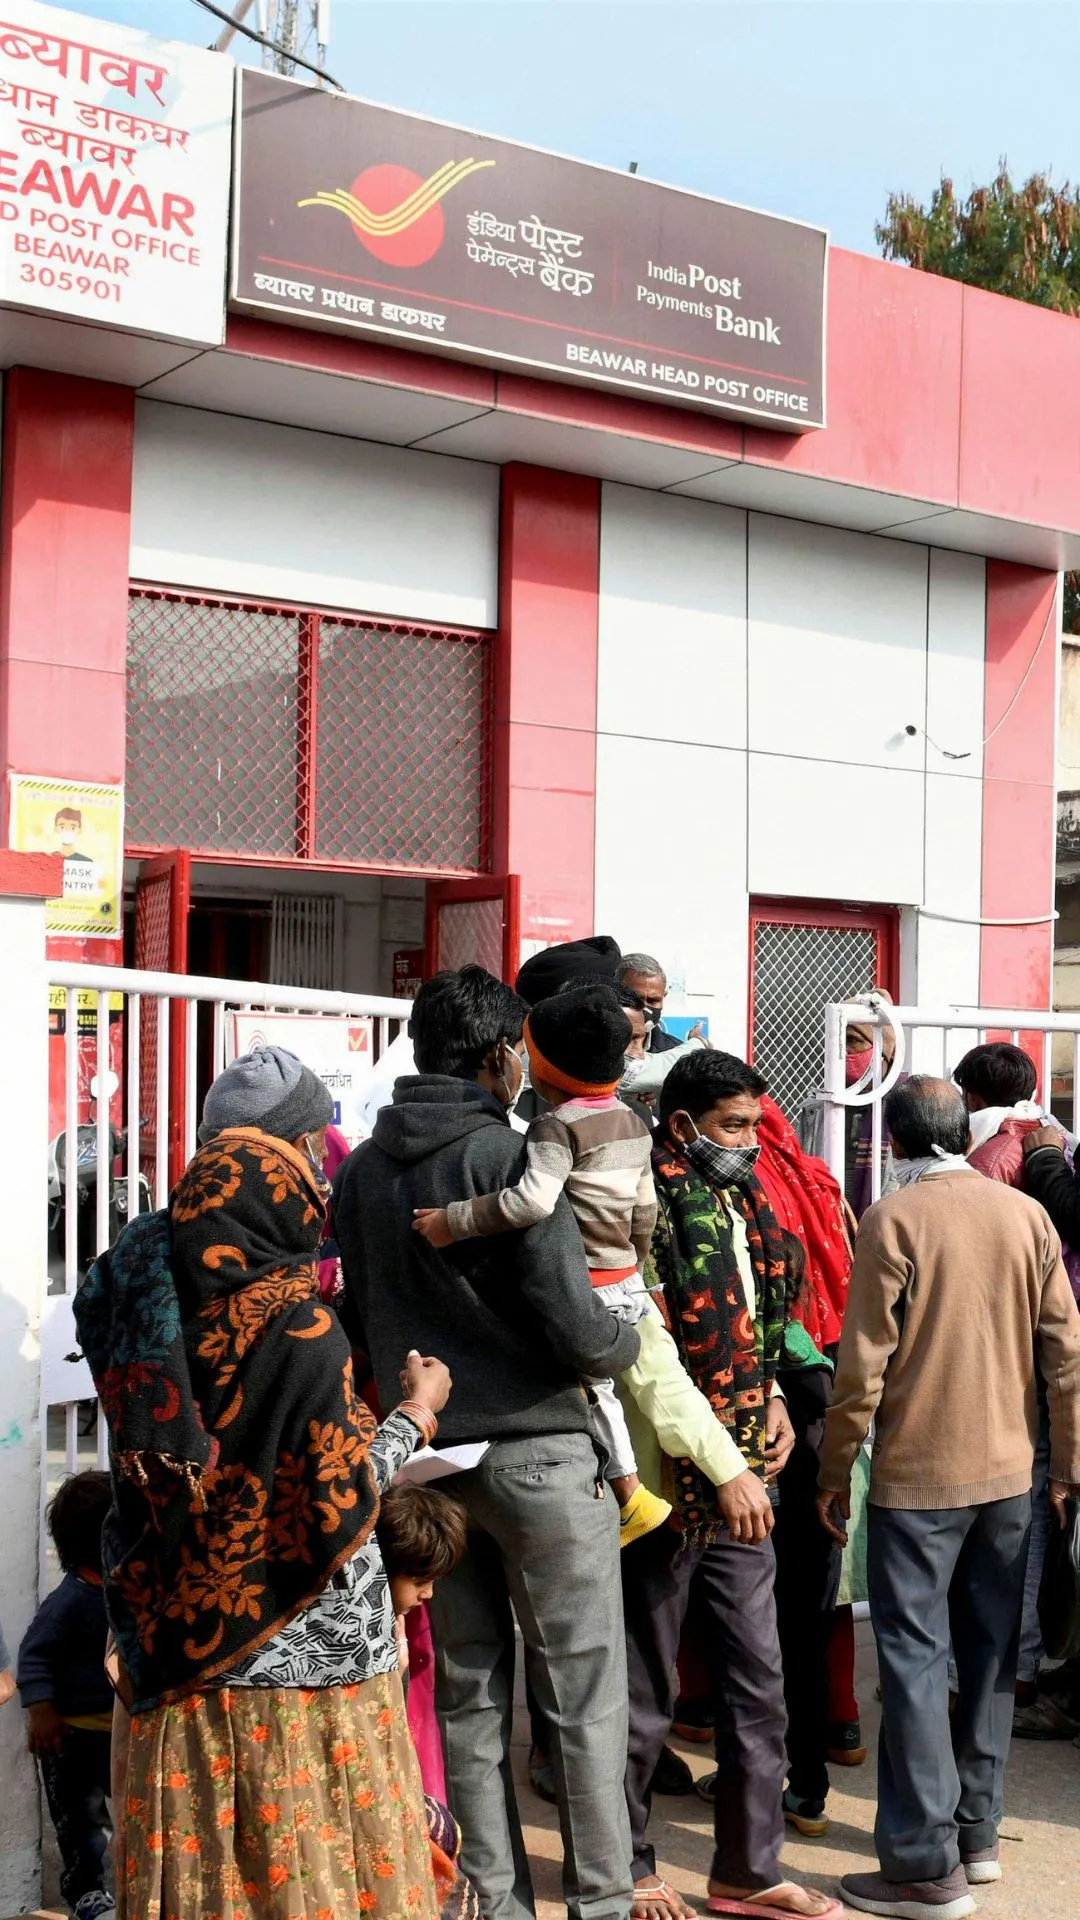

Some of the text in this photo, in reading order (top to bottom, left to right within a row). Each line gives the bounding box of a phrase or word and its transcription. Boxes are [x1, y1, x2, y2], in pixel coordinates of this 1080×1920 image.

[0, 21, 169, 107] ब्यावर
[17, 118, 137, 176] ब्यावर
[73, 100, 190, 154] डाकघर
[0, 151, 195, 238] EAWAR
[14, 233, 130, 277] BEAWAR
[29, 208, 103, 241] POST
[111, 228, 201, 267] OFFICE
[466, 211, 583, 258] इंडिया पोस्ट
[20, 263, 121, 303] 305901
[253, 272, 446, 331] ब्यावर प्रधान डाकघर
[538, 251, 594, 297] बैंक
[566, 343, 808, 412] BEAWAR HEAD POST OFFICE
[63, 881, 94, 890] NTRY
